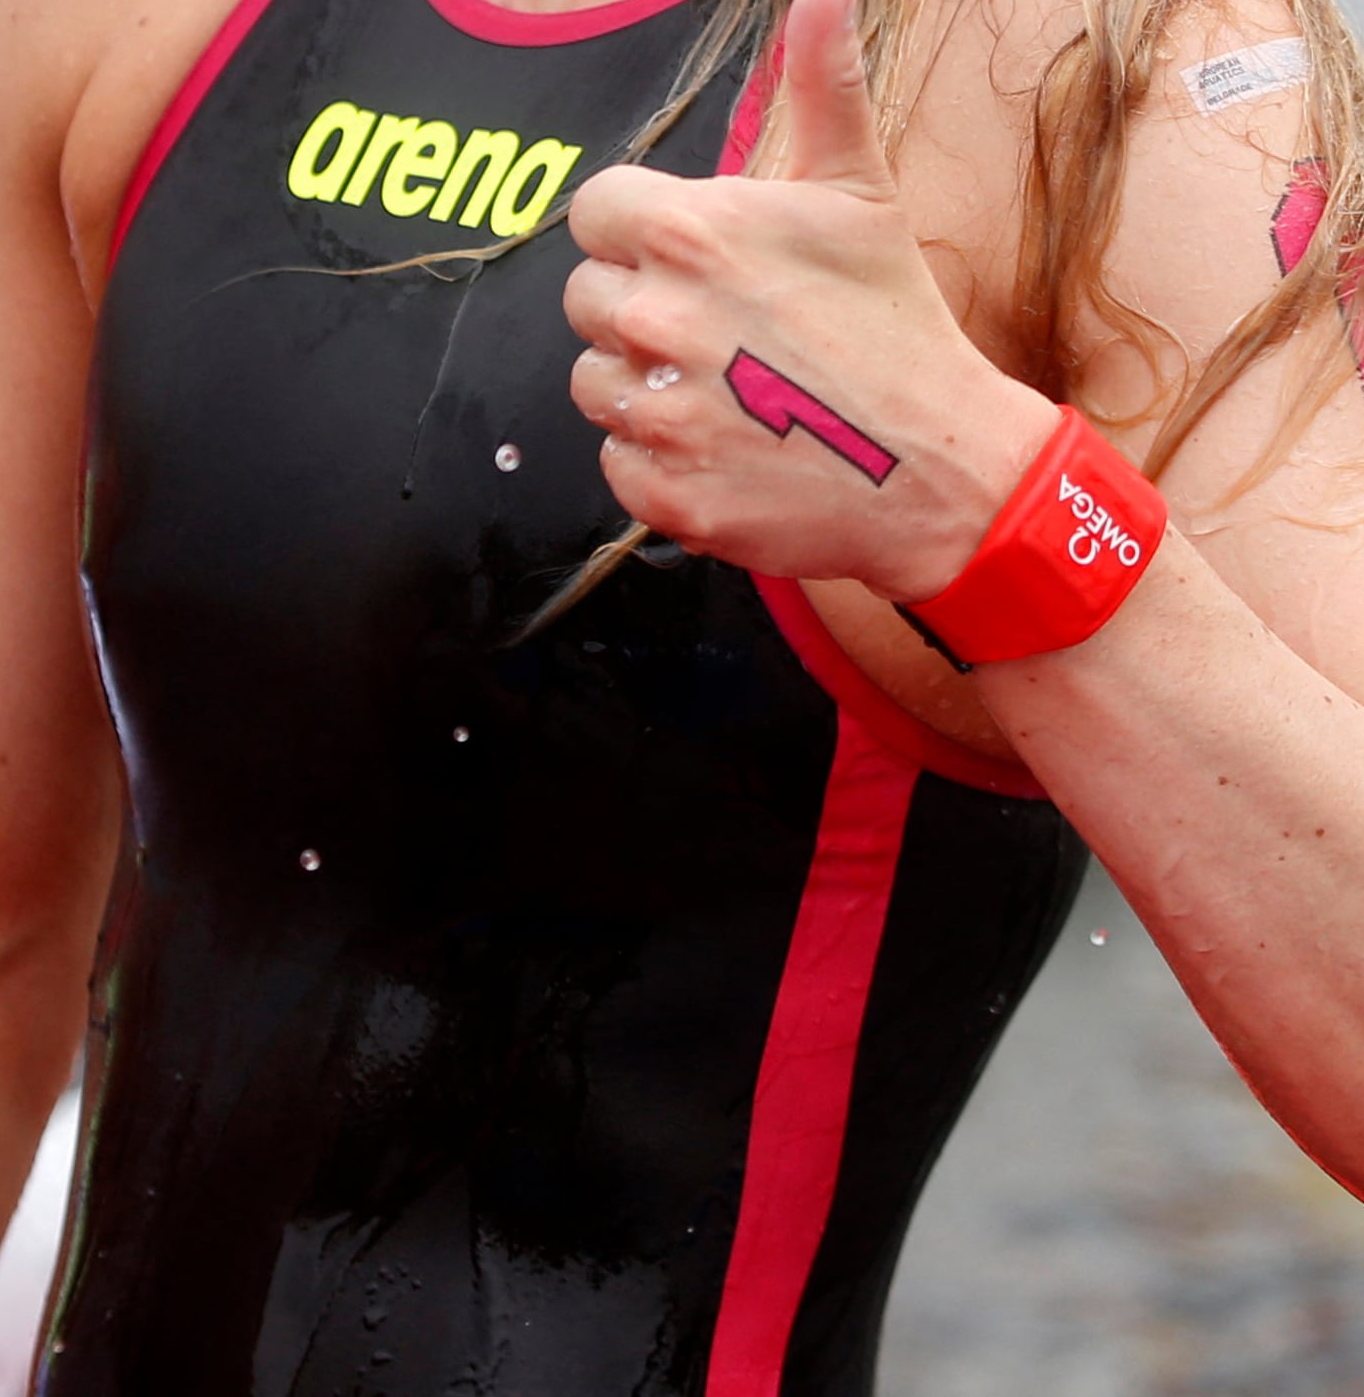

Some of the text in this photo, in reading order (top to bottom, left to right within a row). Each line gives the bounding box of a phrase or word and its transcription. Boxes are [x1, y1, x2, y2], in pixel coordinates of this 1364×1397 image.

[287, 100, 583, 237] arena
[723, 347, 900, 488] 1
[1058, 473, 1140, 566] OMEGA
